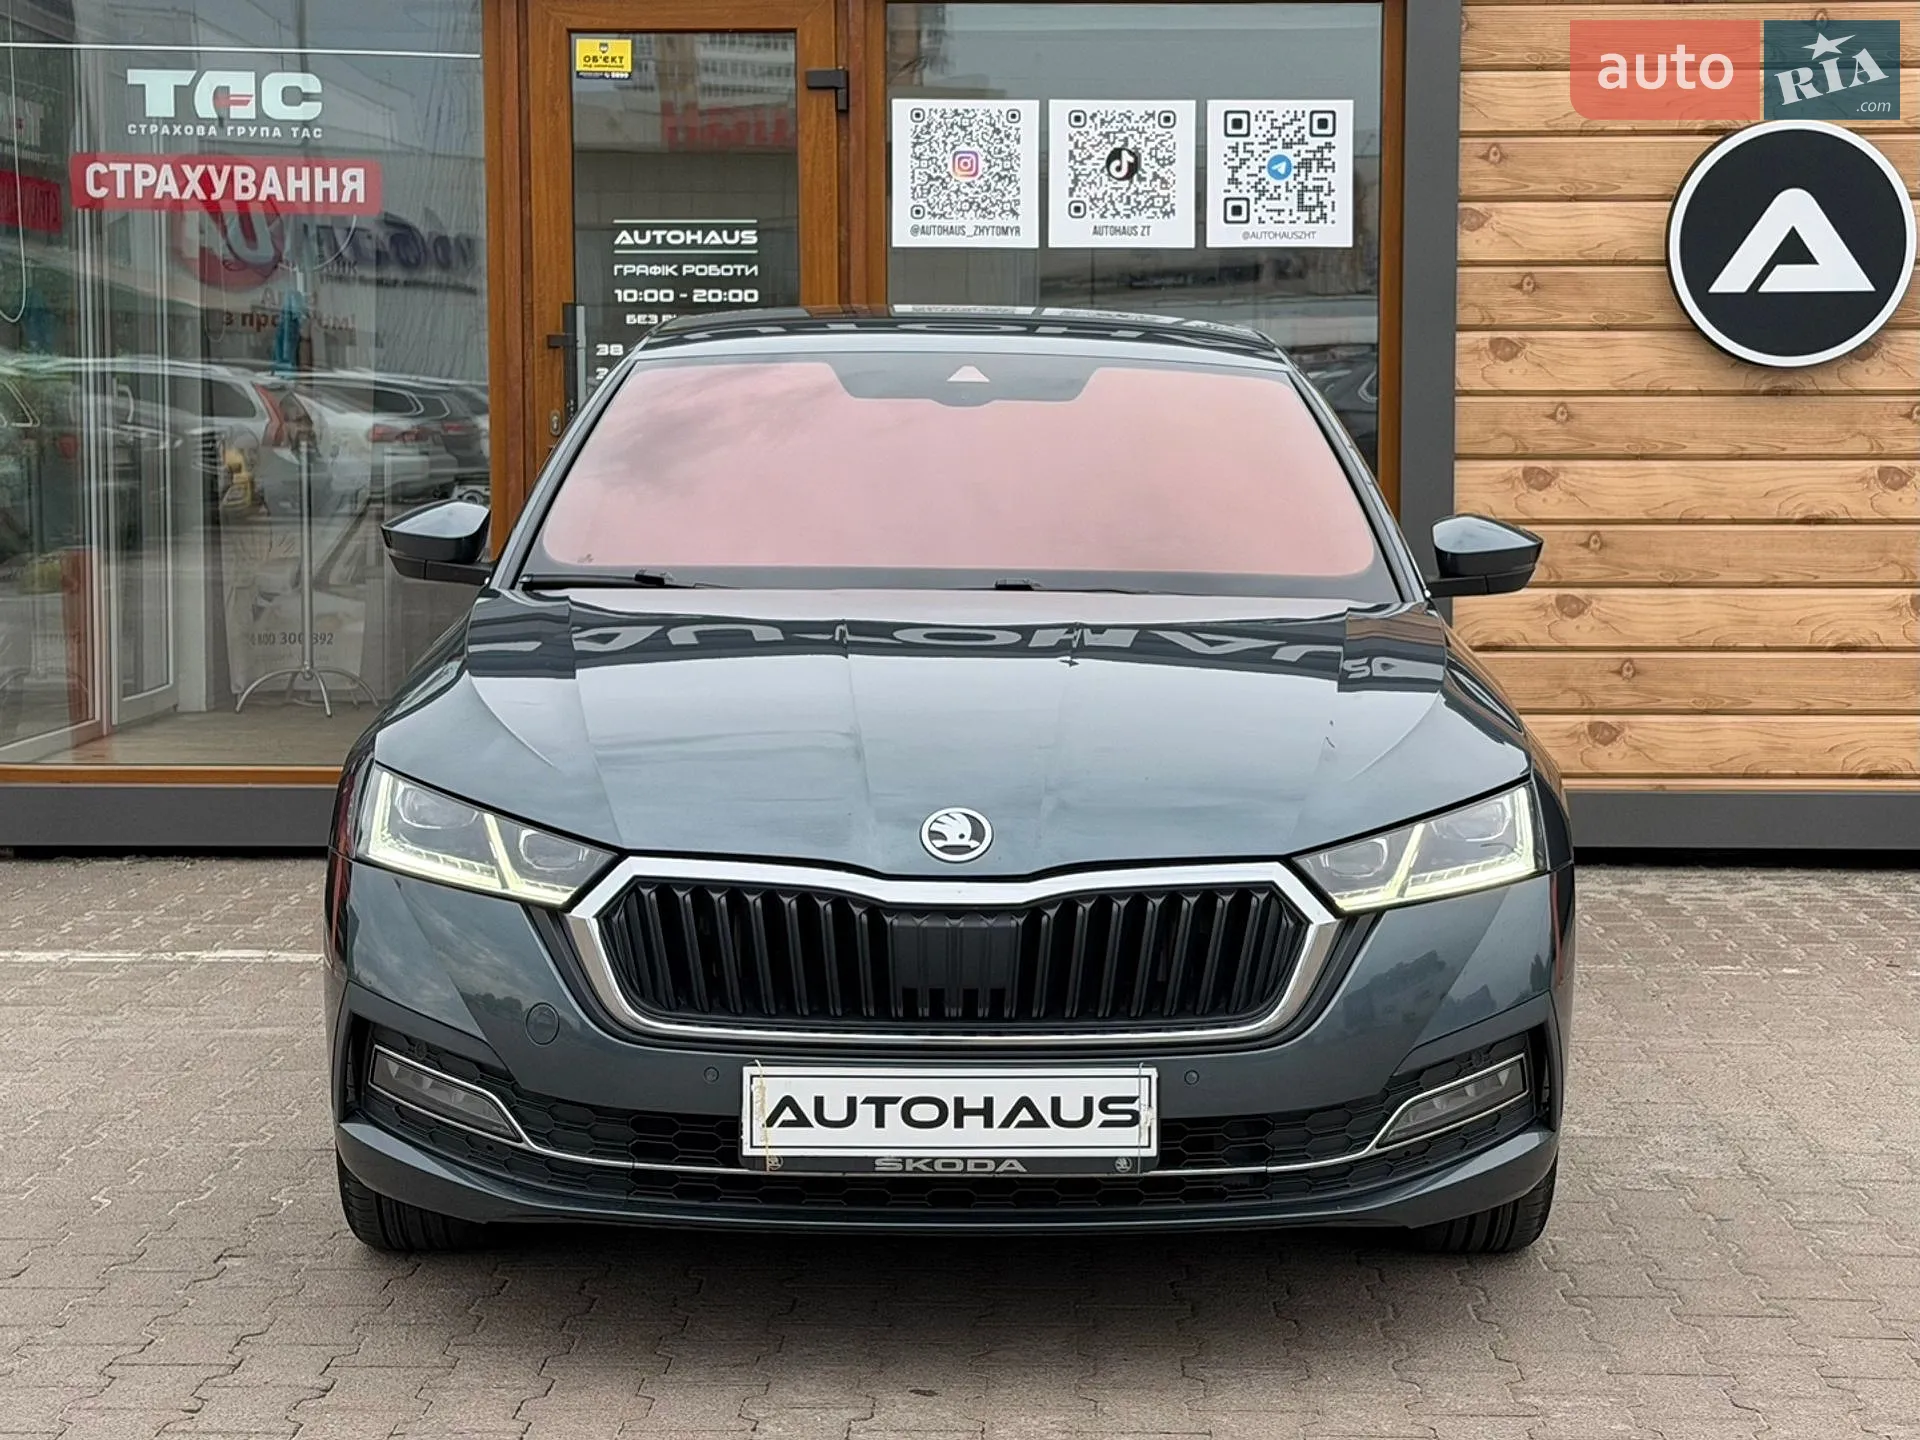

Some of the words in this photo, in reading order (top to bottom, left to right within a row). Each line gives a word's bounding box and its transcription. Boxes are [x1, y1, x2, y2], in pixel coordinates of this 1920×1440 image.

[128, 124, 217, 137] СТРАХОВА
[227, 127, 282, 138] ГРУПА
[291, 128, 323, 139] ТАС
[85, 162, 366, 203] СТРАХУВАННЯ
[614, 230, 758, 245] AUTOHAUS
[910, 224, 1021, 237] @AUTOHAUS_ZHYTOMYR
[1092, 225, 1138, 236] AUTOHAUS
[1140, 226, 1151, 236] ZT
[614, 264, 678, 276] ГРАФІК
[682, 264, 758, 276] РОБОТИ
[614, 289, 674, 302] 10:00
[692, 289, 759, 302] 20:00
[766, 1095, 1141, 1129] AUTOHAUS
